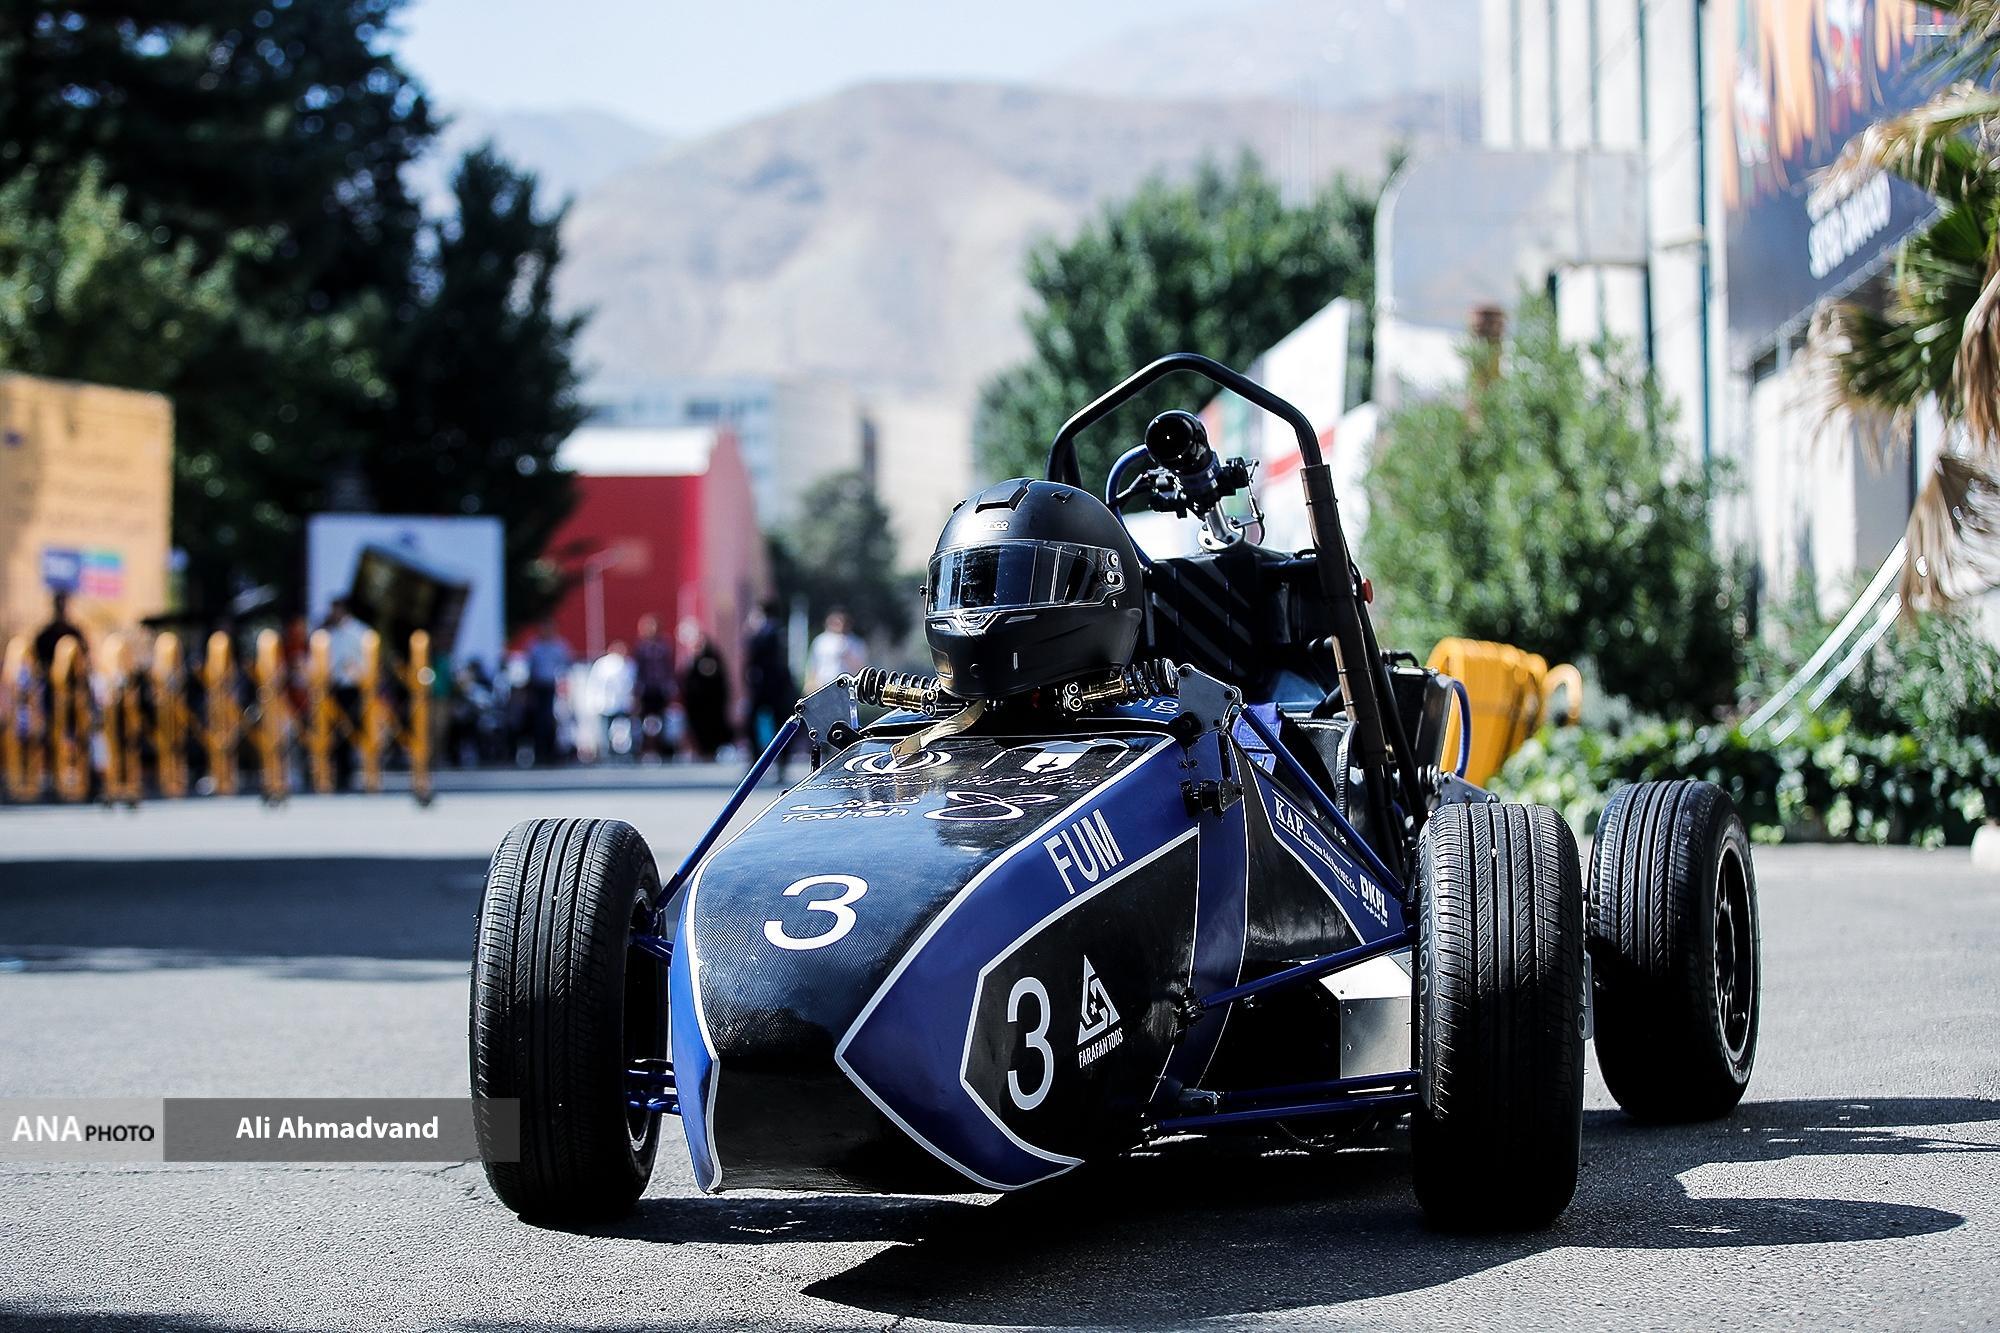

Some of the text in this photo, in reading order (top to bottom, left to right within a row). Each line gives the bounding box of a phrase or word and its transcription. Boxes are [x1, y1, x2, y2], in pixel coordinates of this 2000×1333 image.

[1043, 808, 1125, 895] FUM
[1274, 796, 1304, 838] KAP
[763, 873, 869, 951] 3
[1007, 976, 1055, 1111] 3
